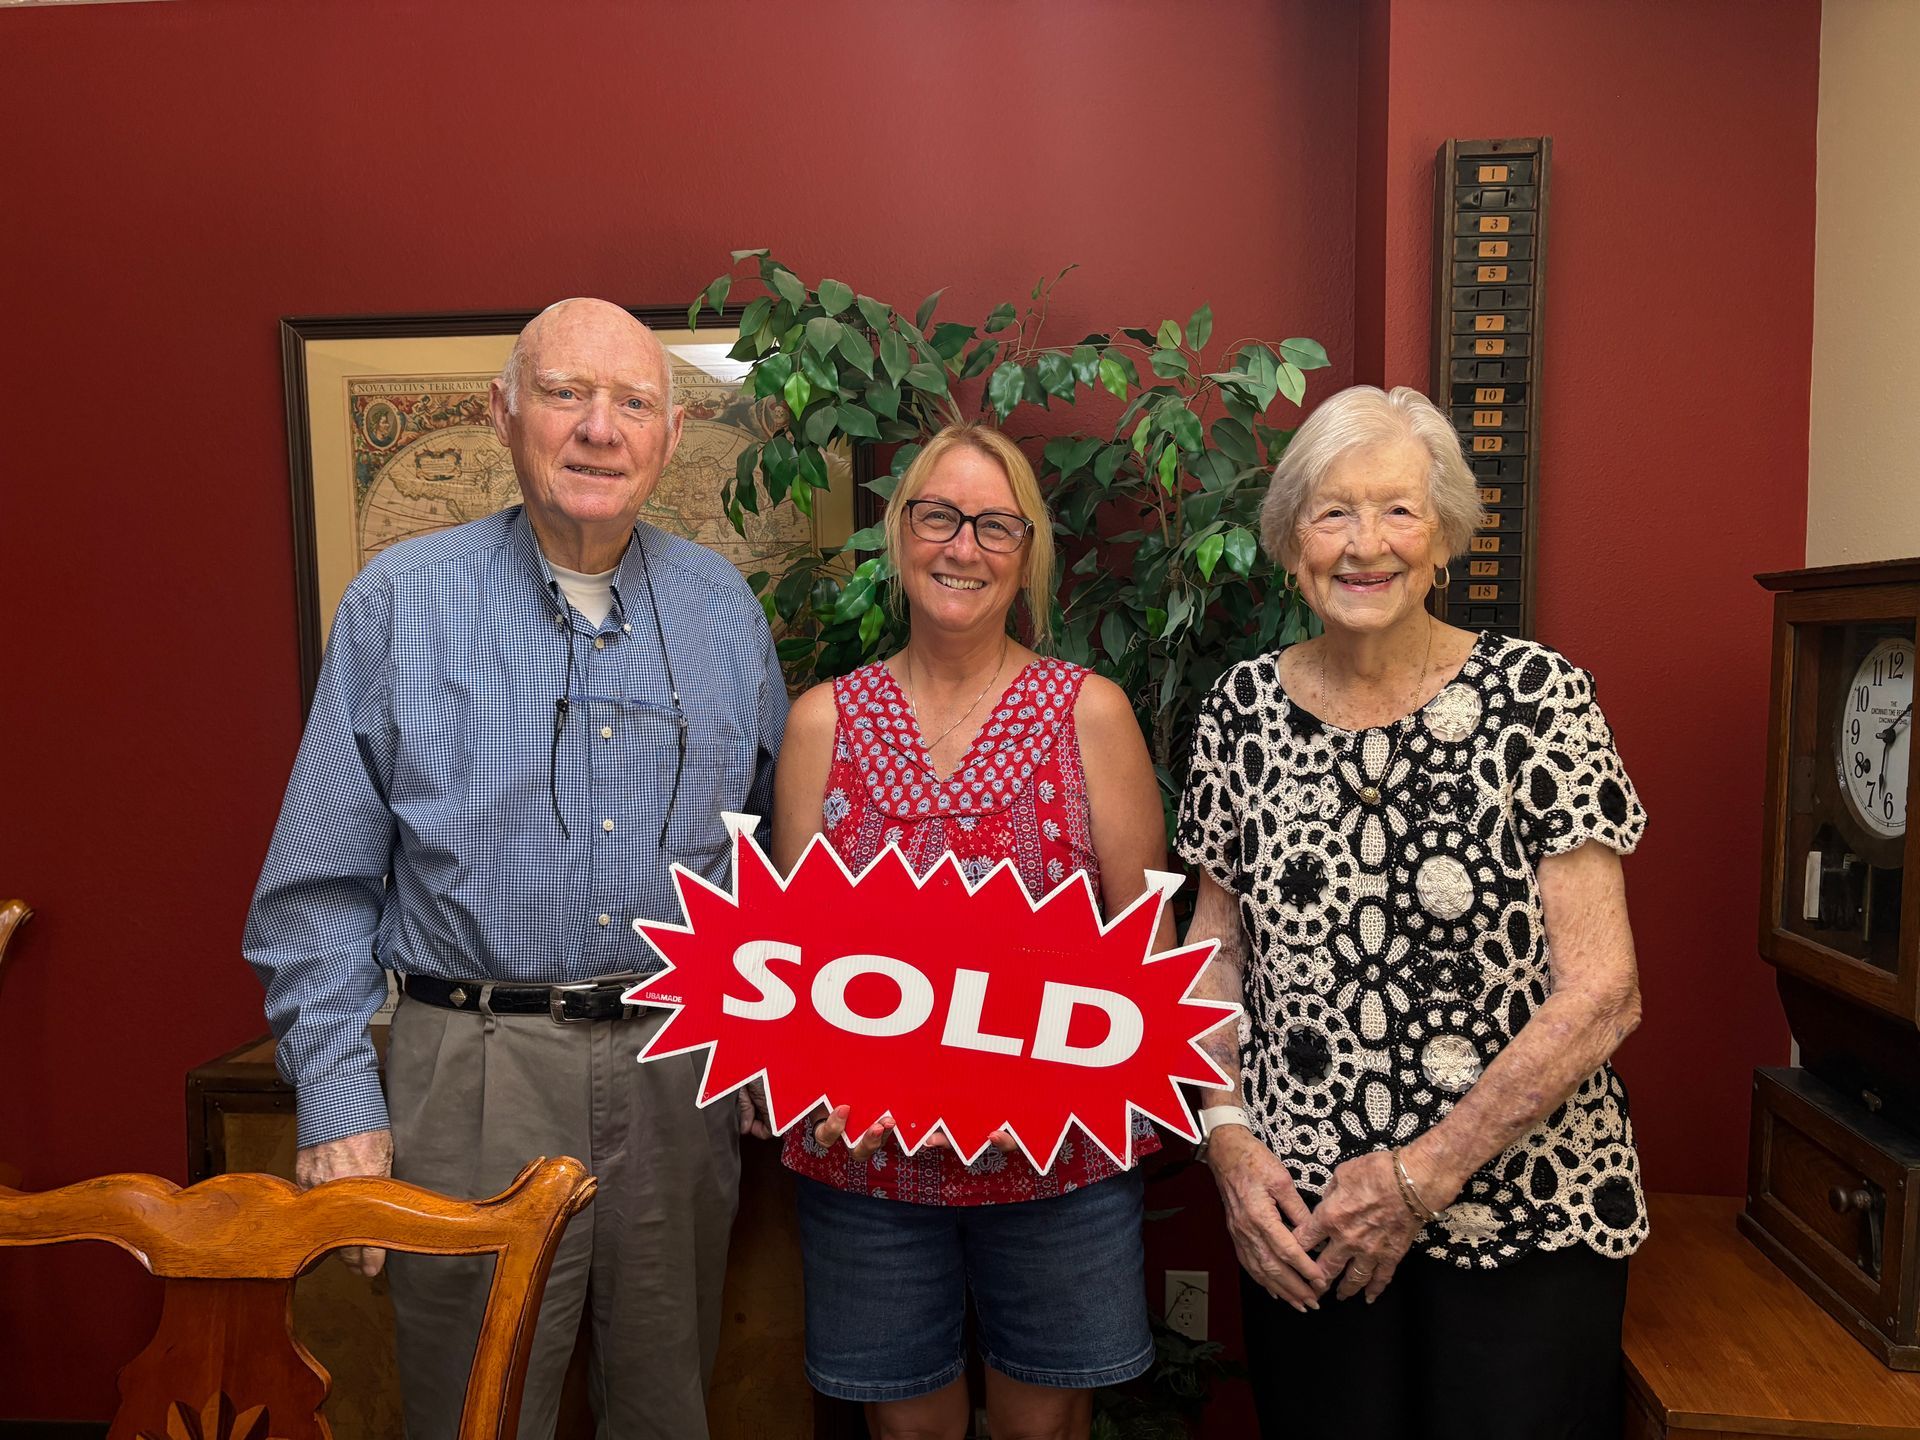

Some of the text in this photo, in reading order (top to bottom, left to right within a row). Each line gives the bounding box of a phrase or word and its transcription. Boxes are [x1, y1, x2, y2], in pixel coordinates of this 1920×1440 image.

[1490, 168, 1496, 179] 1
[1490, 218, 1498, 230] 3
[1489, 243, 1497, 255] 4
[1488, 268, 1496, 279] 5
[1486, 318, 1494, 329] 7
[1485, 340, 1494, 351] 8
[358, 383, 385, 393] NOVA
[388, 382, 425, 392] TOTIVS
[428, 381, 482, 391] TERRARVM
[1482, 389, 1497, 401] 10
[1481, 412, 1494, 424] 11
[1481, 438, 1496, 449] 12
[1478, 538, 1492, 549] 16
[1477, 562, 1492, 573] 17
[1476, 586, 1491, 597] 18
[1888, 651, 1905, 679] 12
[1872, 658, 1884, 686] 11
[1855, 685, 1869, 713] 10
[1851, 719, 1861, 745] 9
[1854, 752, 1864, 778] 8
[1865, 781, 1876, 808] 7
[1884, 792, 1893, 820] 6
[722, 940, 1144, 1067] SOLD
